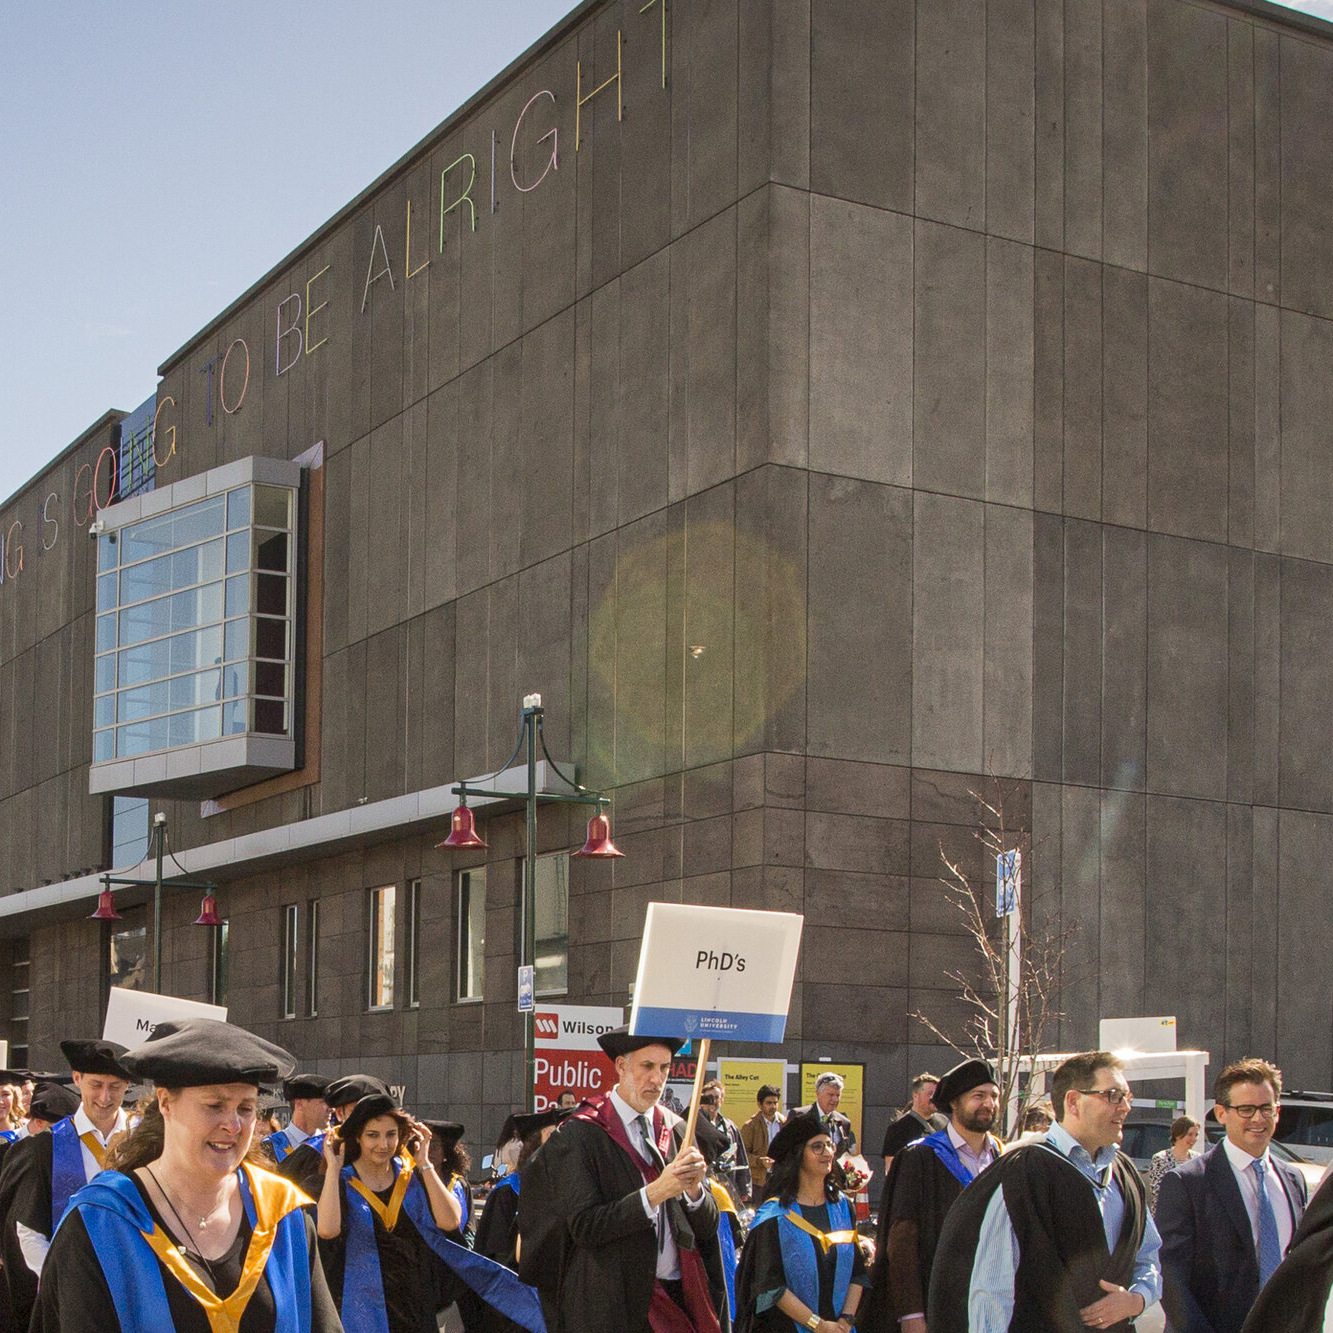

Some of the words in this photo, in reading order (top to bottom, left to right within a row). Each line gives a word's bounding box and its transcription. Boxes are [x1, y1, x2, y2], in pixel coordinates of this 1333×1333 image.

[38, 490, 58, 557] IS
[73, 396, 176, 526] GOING
[198, 339, 249, 427] TO
[276, 265, 330, 376] BE
[362, 0, 666, 314] ALRIGHT
[695, 950, 746, 972] PhD's
[562, 1019, 614, 1035] Wilson
[534, 1057, 602, 1089] Public
[725, 1073, 734, 1081] The
[735, 1074, 749, 1082] Alley
